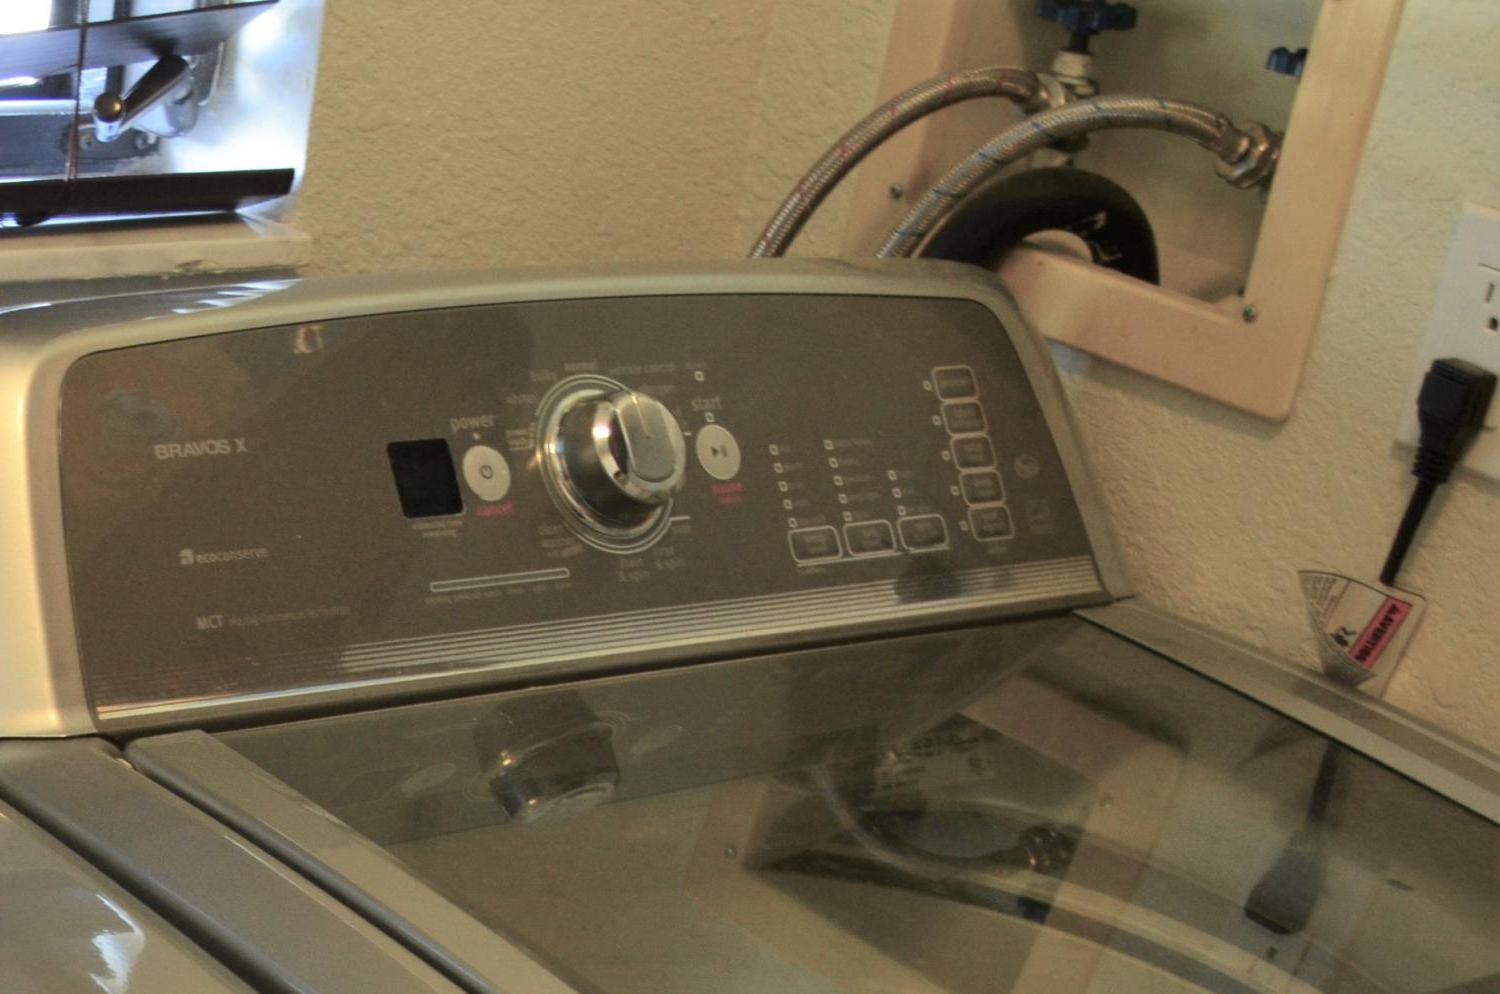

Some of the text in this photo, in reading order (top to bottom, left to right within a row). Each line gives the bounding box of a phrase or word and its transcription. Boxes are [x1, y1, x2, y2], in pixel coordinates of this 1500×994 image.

[449, 415, 495, 433] power
[153, 437, 249, 460] BRAVOS X
